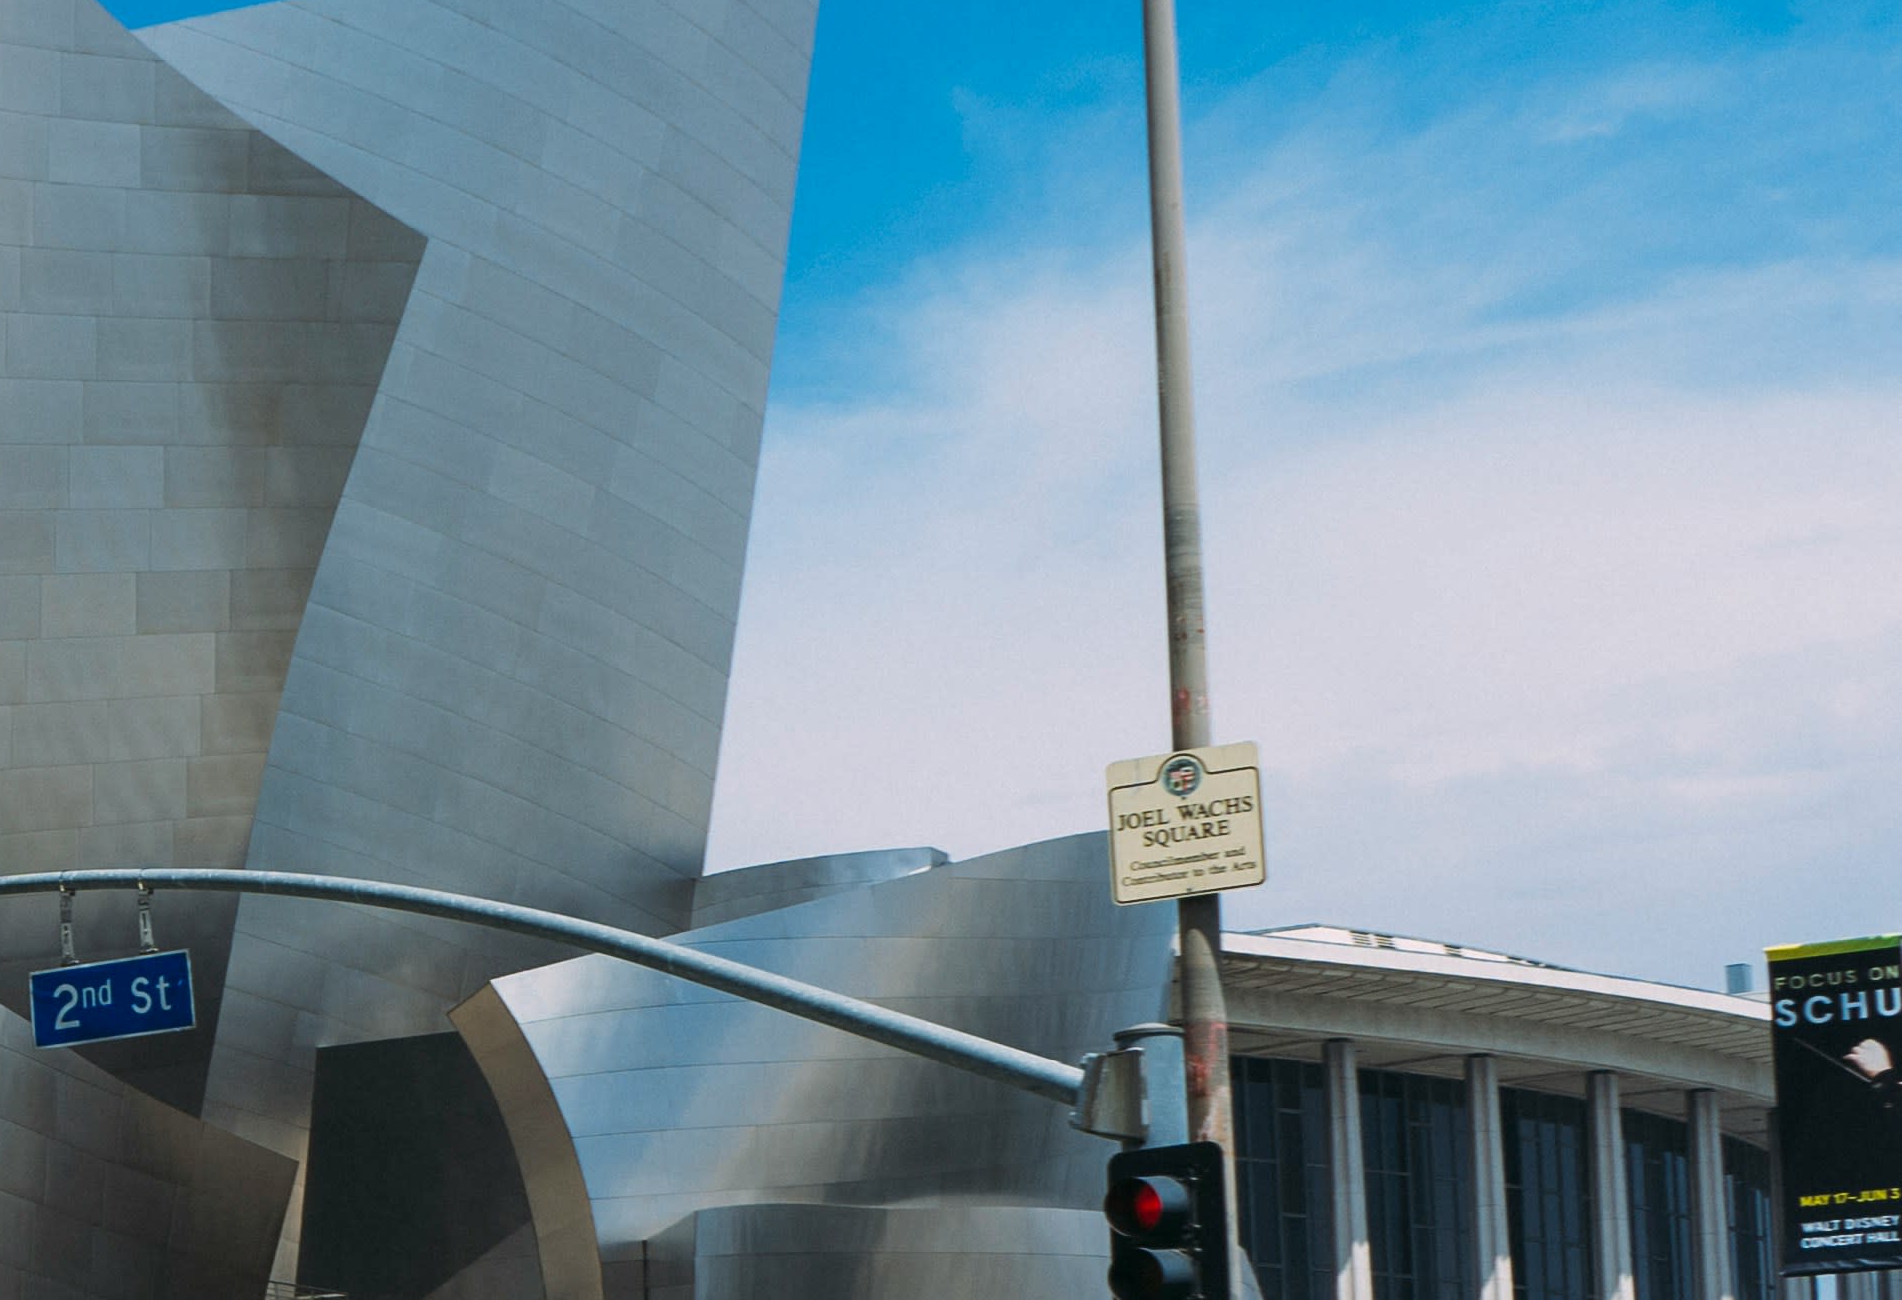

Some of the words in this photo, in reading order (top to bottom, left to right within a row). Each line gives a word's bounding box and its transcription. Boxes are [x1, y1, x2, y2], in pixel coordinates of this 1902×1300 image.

[1117, 808, 1169, 831] JOEL
[1176, 796, 1253, 820] WACHS
[1142, 820, 1230, 847] SQUARE
[1225, 846, 1246, 857] and
[1192, 868, 1204, 876] to
[1209, 865, 1226, 875] the
[1232, 861, 1257, 871] Arts
[1774, 970, 1857, 990] FOCUS
[1869, 965, 1899, 981] ON
[53, 979, 112, 1030] 2nd
[131, 975, 171, 1014] St
[1776, 988, 1902, 1026] SCHU
[1799, 1195, 1830, 1207] MAY
[1801, 1219, 1840, 1233] WALT
[1844, 1215, 1900, 1229] DISNEY
[1800, 1233, 1863, 1249] CONCERT
[1866, 1231, 1900, 1244] HALL
